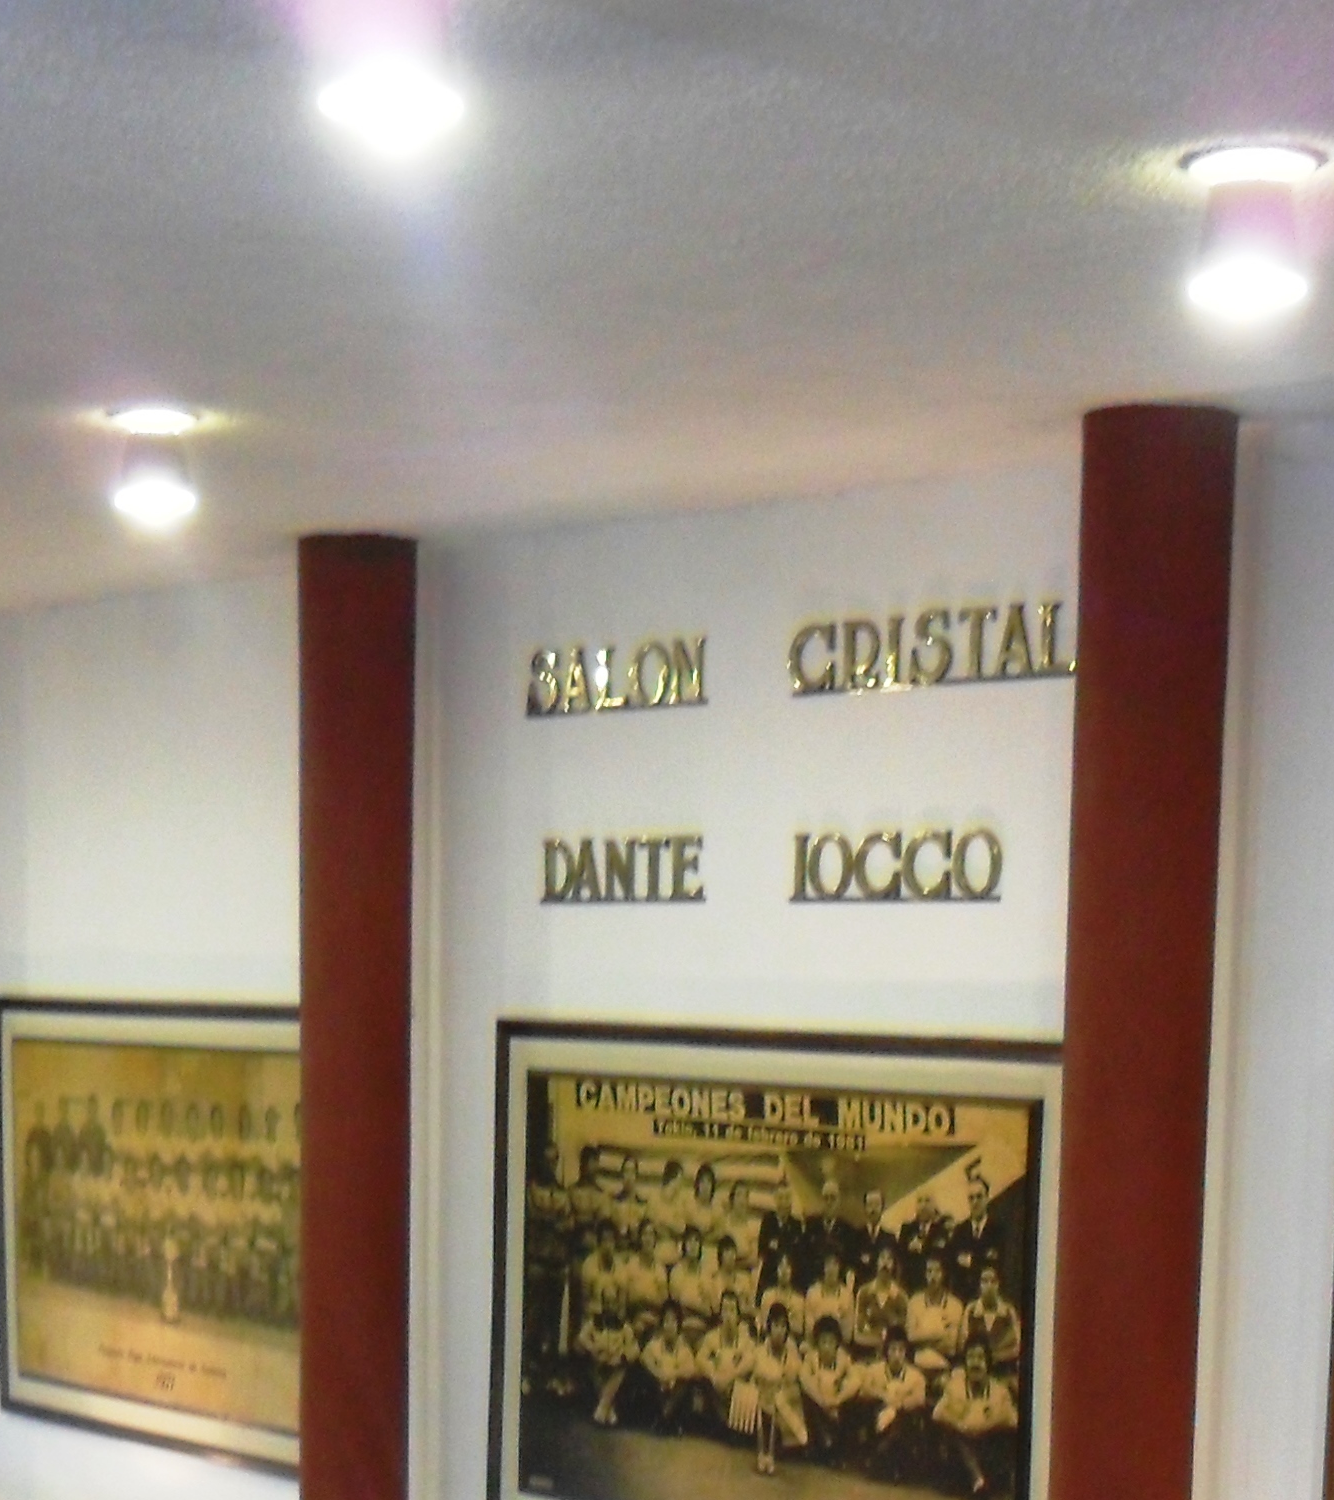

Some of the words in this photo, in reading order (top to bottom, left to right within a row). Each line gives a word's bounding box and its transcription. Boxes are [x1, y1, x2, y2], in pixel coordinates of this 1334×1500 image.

[526, 635, 708, 717] SALON
[787, 600, 1078, 697] CRISTAL
[541, 835, 706, 903] DANTE
[788, 829, 1005, 902] IOCCO
[577, 1079, 746, 1120] CAMPEONES
[763, 1091, 820, 1127] DEL
[837, 1097, 955, 1136] MUNDO
